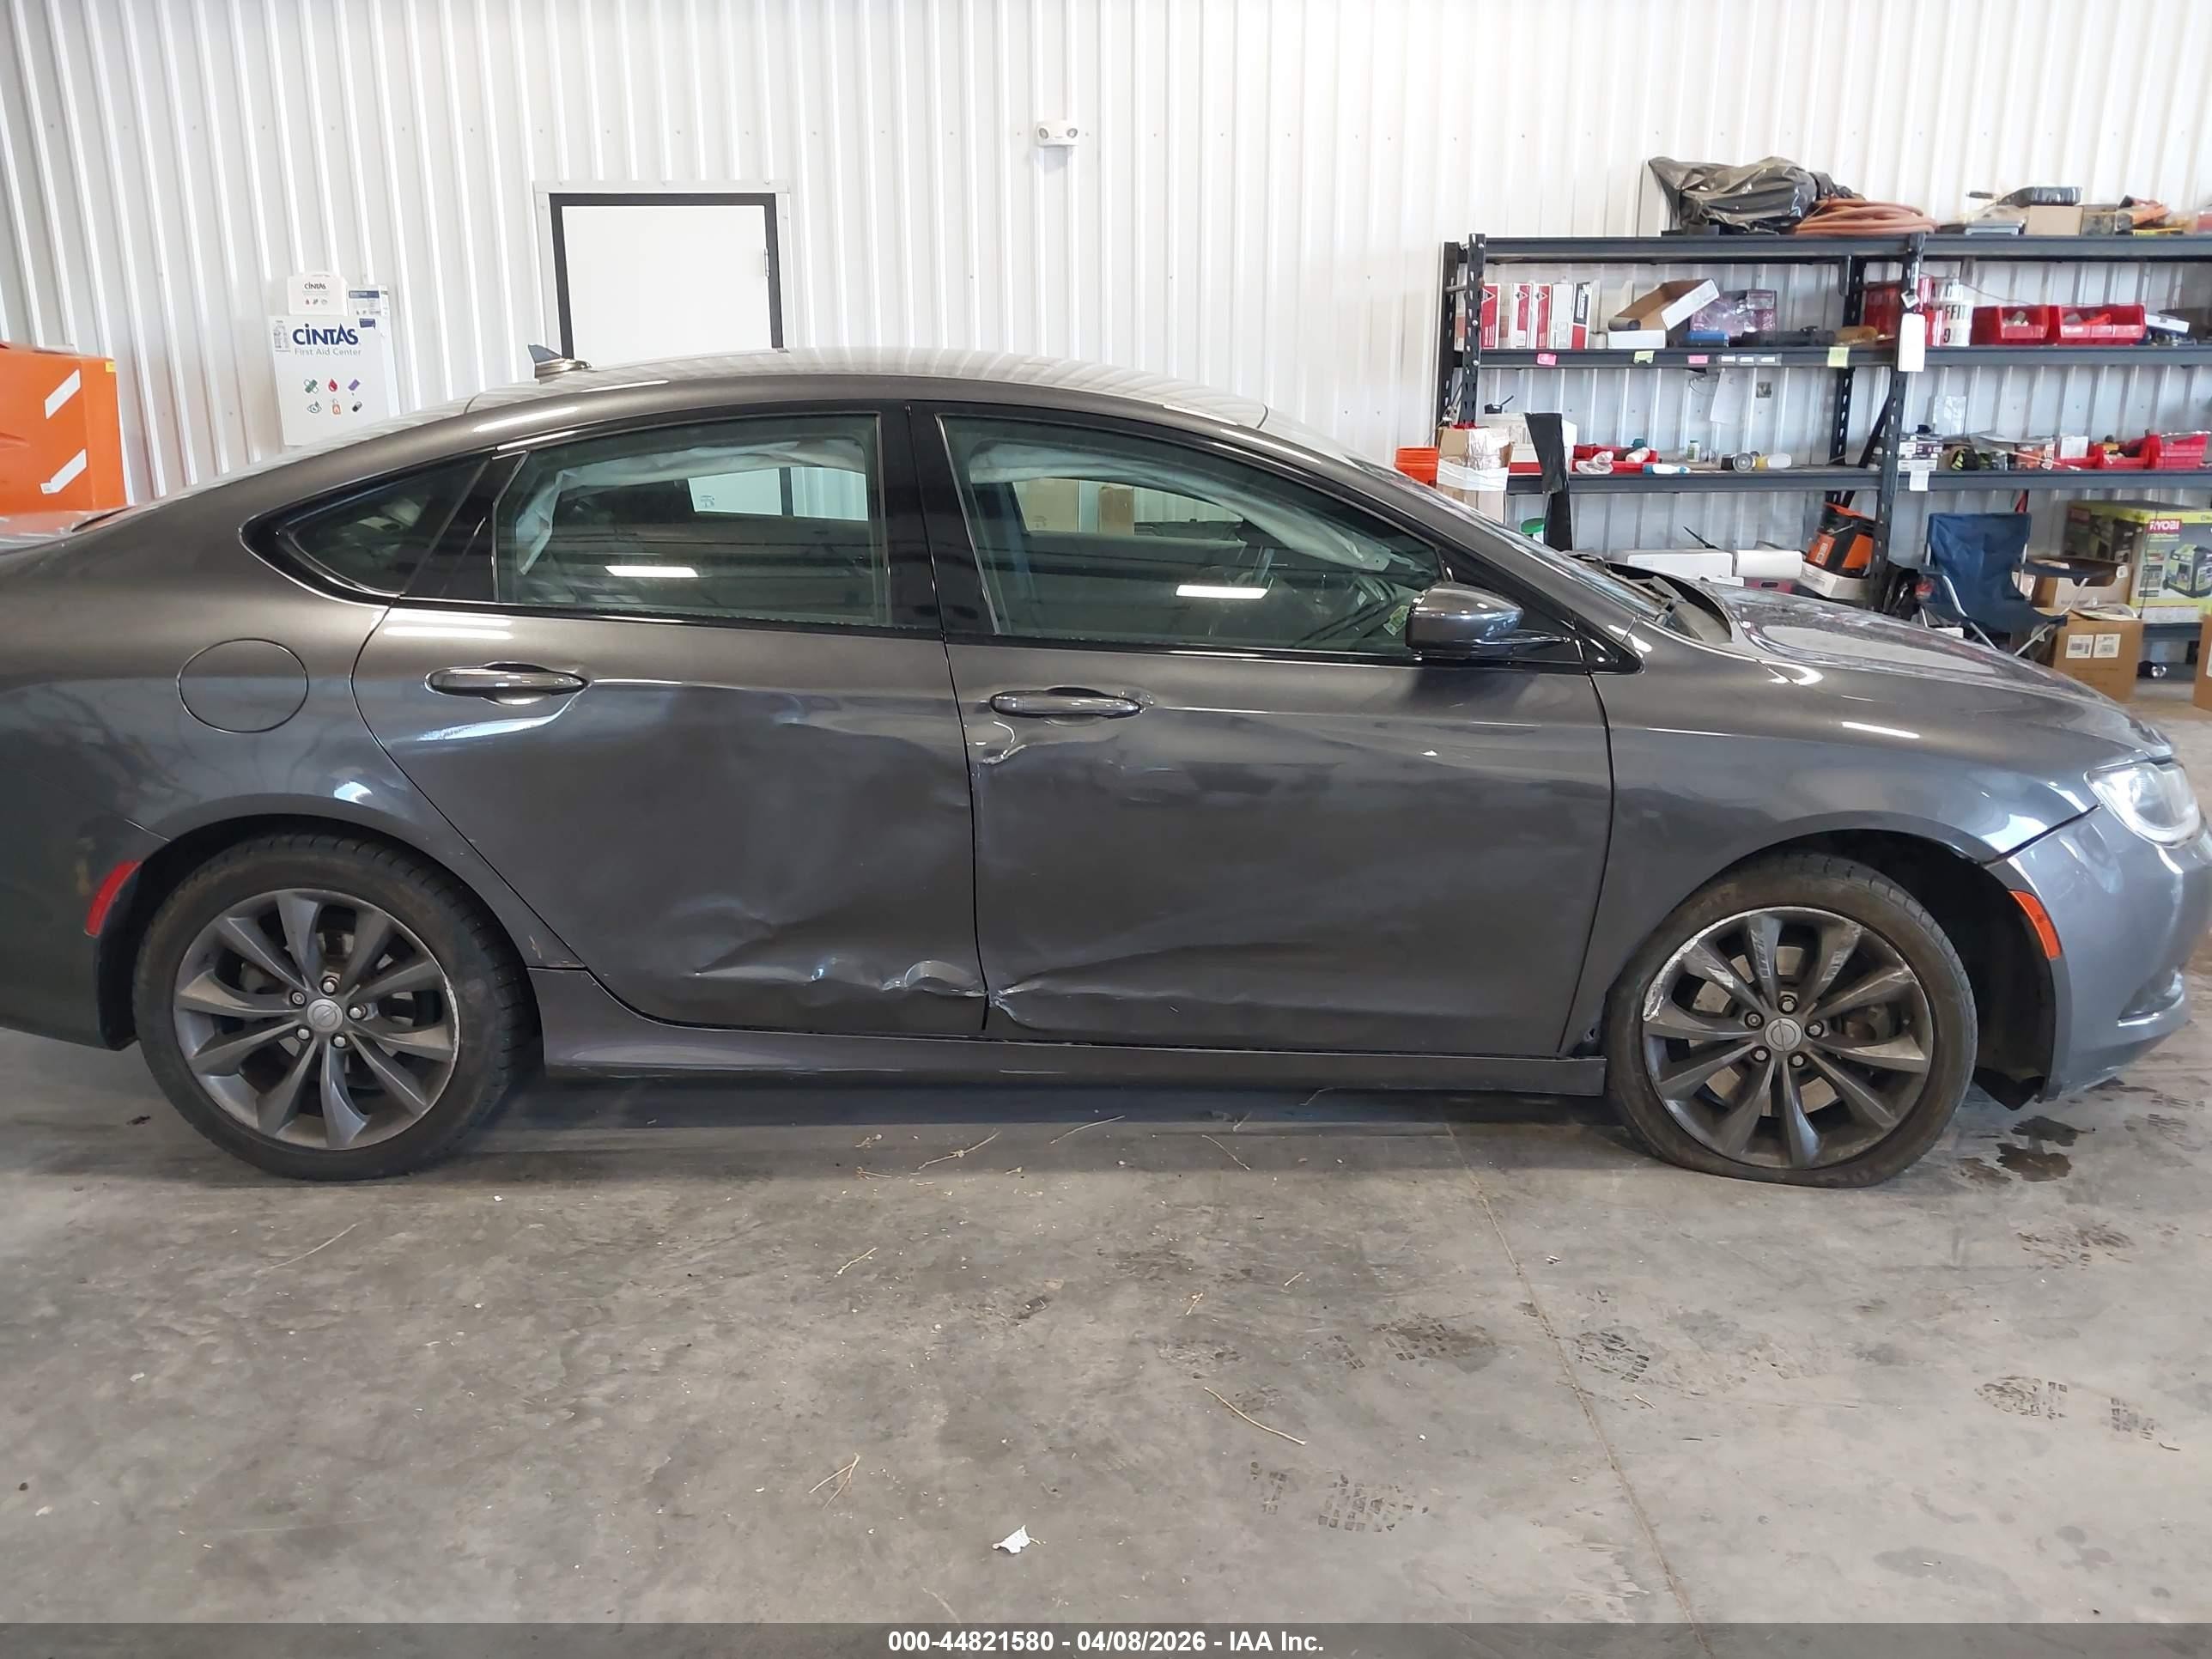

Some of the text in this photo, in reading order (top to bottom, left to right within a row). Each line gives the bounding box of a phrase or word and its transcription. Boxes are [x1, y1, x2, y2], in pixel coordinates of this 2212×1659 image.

[295, 346, 362, 356] First Aid Center
[2149, 520, 2180, 531] RYOBI
